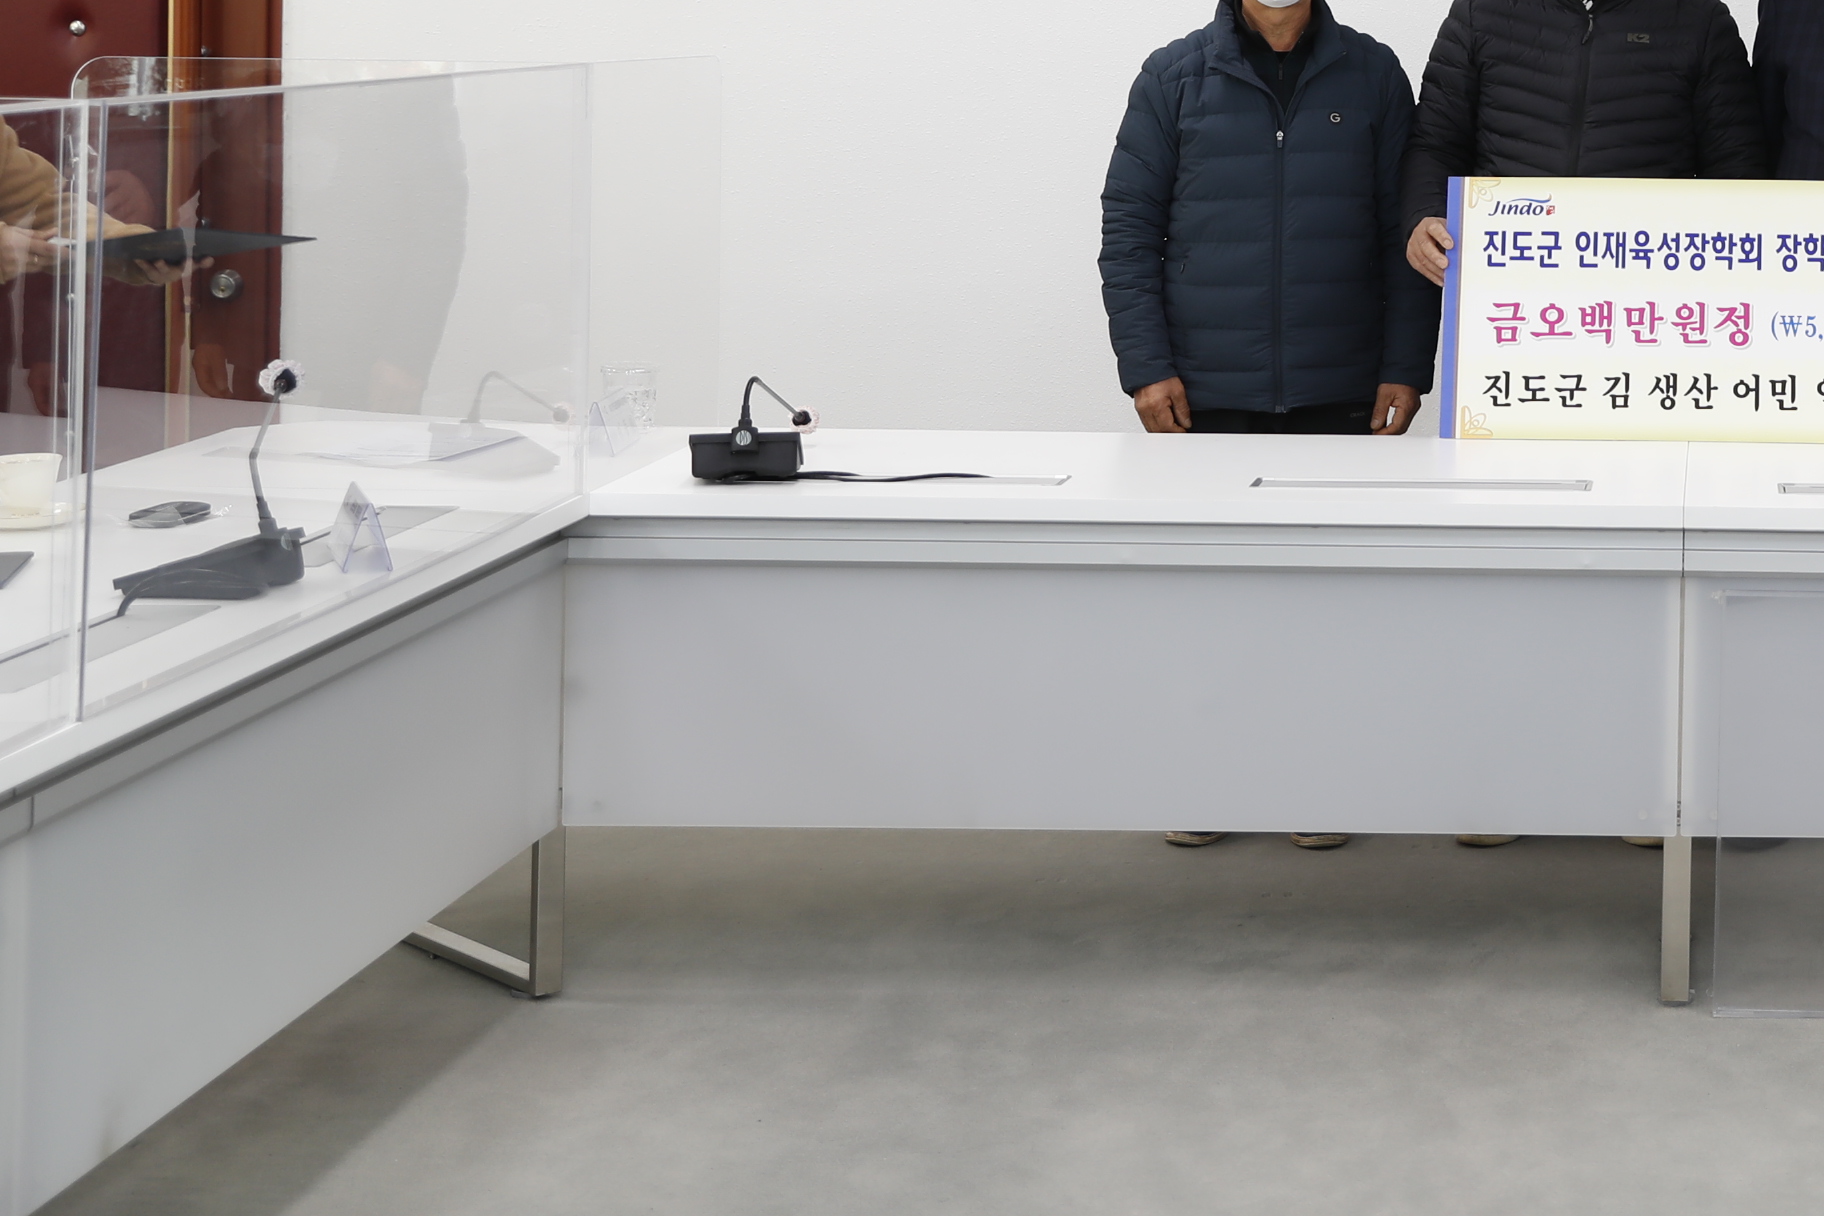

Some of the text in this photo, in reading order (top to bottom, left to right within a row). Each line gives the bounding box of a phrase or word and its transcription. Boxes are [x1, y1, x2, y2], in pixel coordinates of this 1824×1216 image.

[1627, 32, 1650, 43] K2
[1487, 200, 1544, 217] Jindo
[1482, 230, 1563, 269] 진도군
[1574, 230, 1763, 272] 인재육성장학회
[1486, 300, 1753, 346] 금오백만원정
[1482, 370, 1588, 409] 진도군
[1602, 371, 1631, 410] 김
[1647, 372, 1719, 411] 생산
[1732, 373, 1799, 413] 어민
